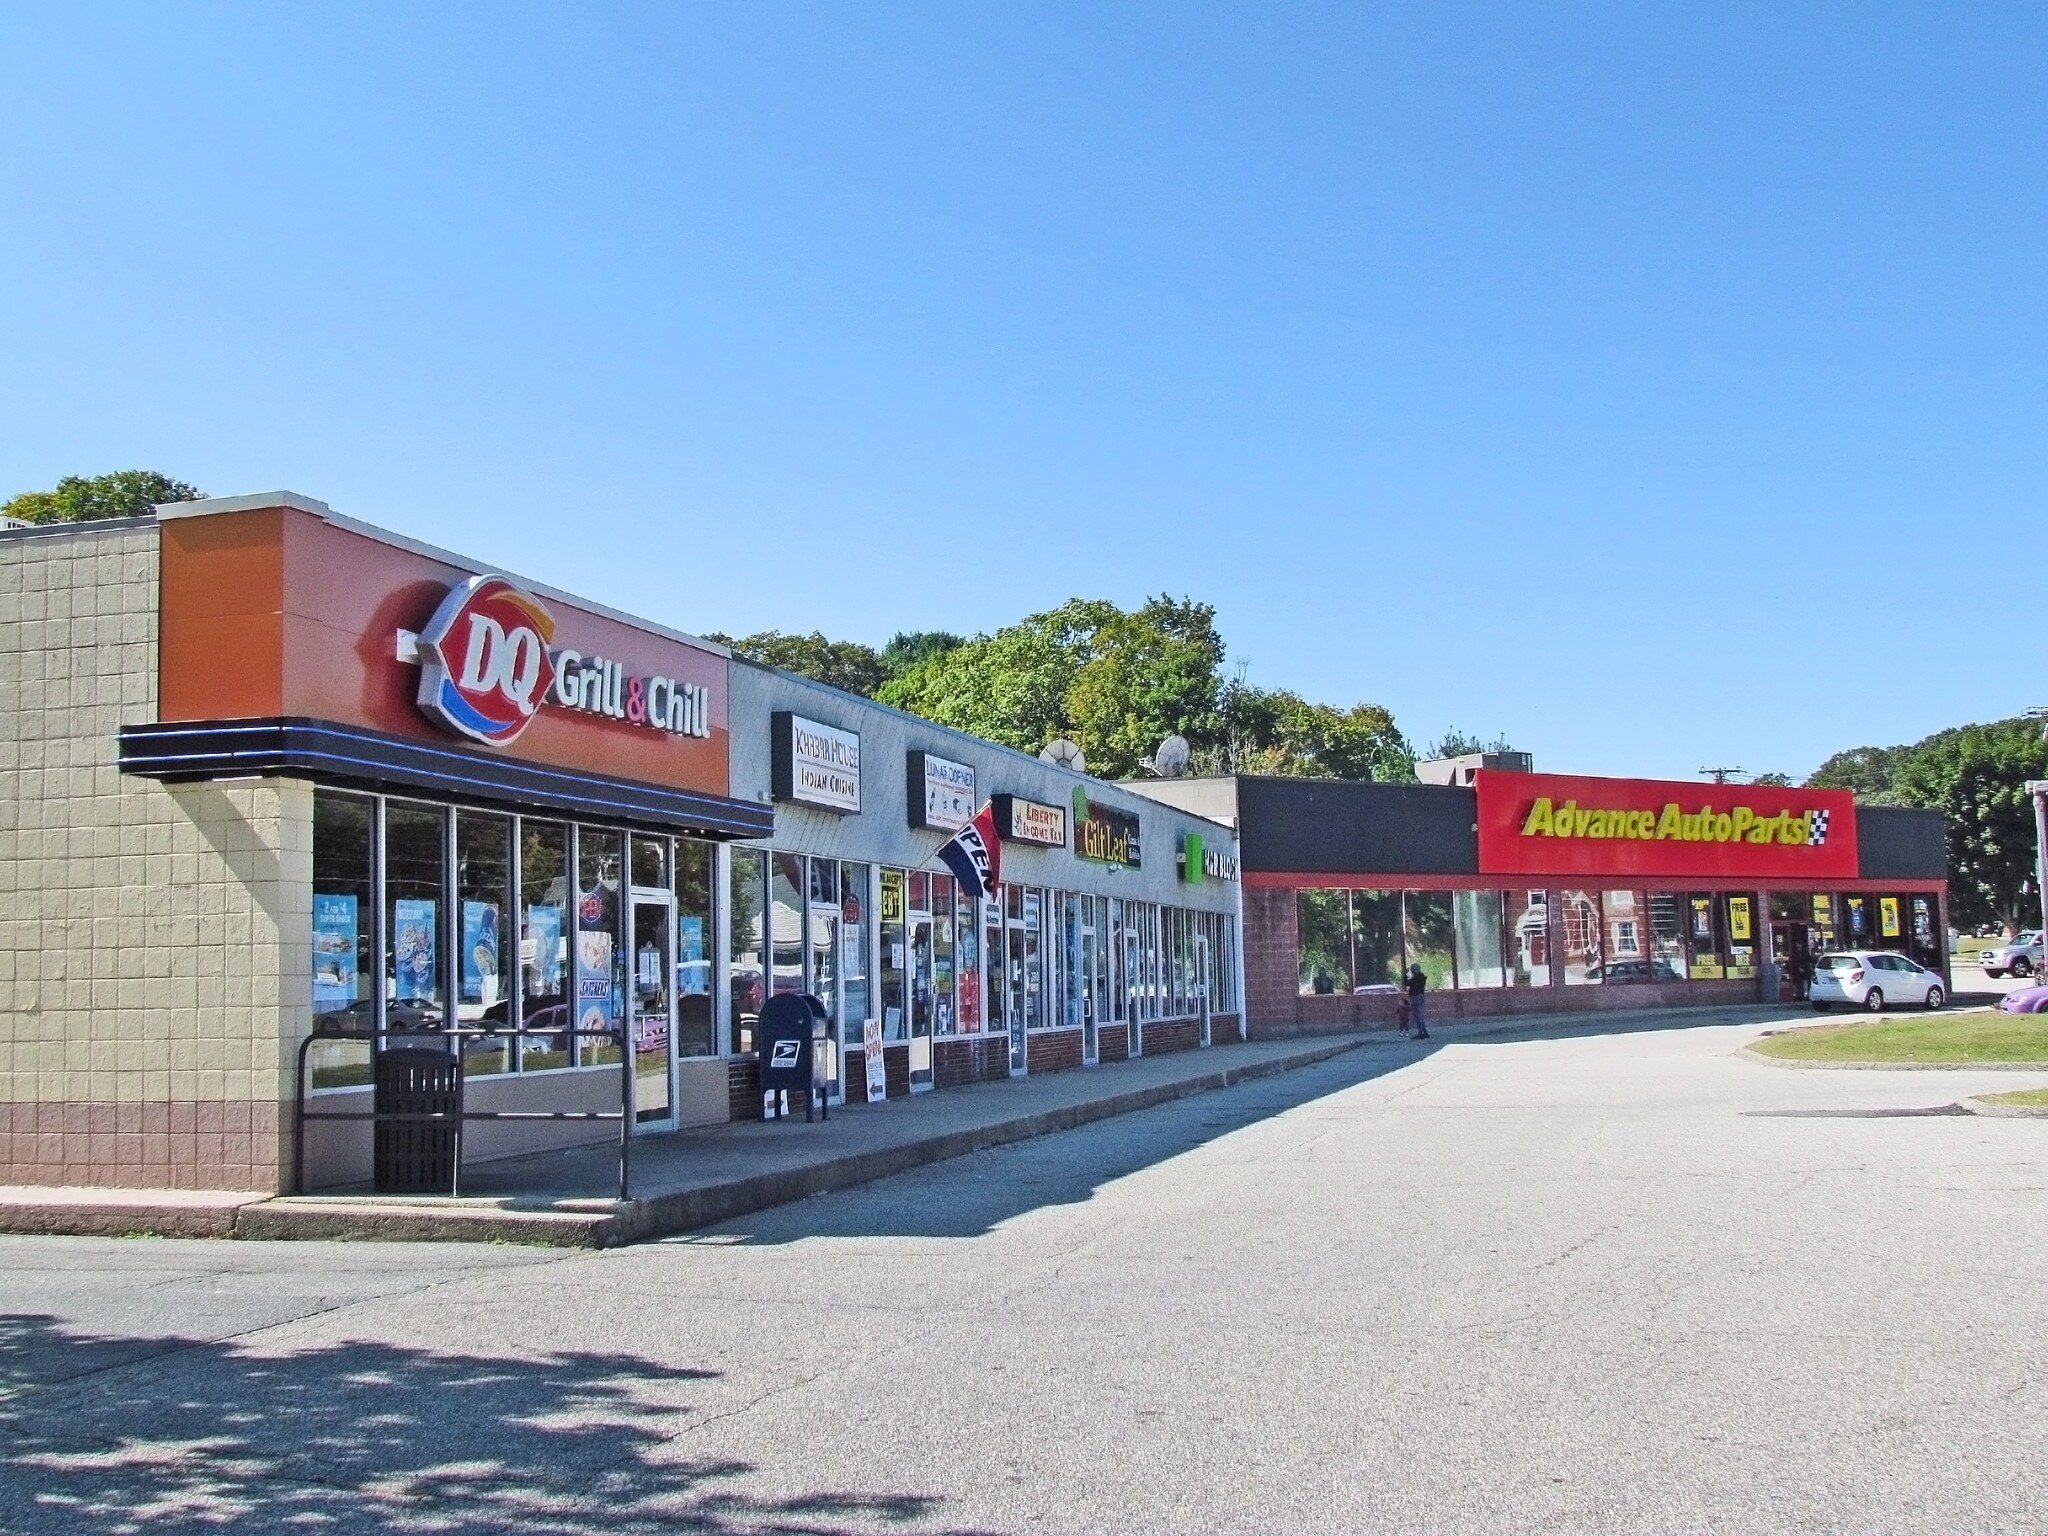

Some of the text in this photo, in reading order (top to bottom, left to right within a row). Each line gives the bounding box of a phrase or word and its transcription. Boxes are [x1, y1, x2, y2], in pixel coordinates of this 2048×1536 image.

[459, 612, 710, 738] DQ Grill & Chill
[796, 727, 858, 769] KHABAR HOUSE
[801, 767, 855, 797] INDIAN CUISINE
[1023, 822, 1062, 842] INCOME TAX
[1026, 803, 1059, 827] LIBERTY
[1521, 797, 1655, 839] Advance
[1085, 819, 1128, 863] Gilt Leaf
[1731, 902, 1747, 912] FREE
